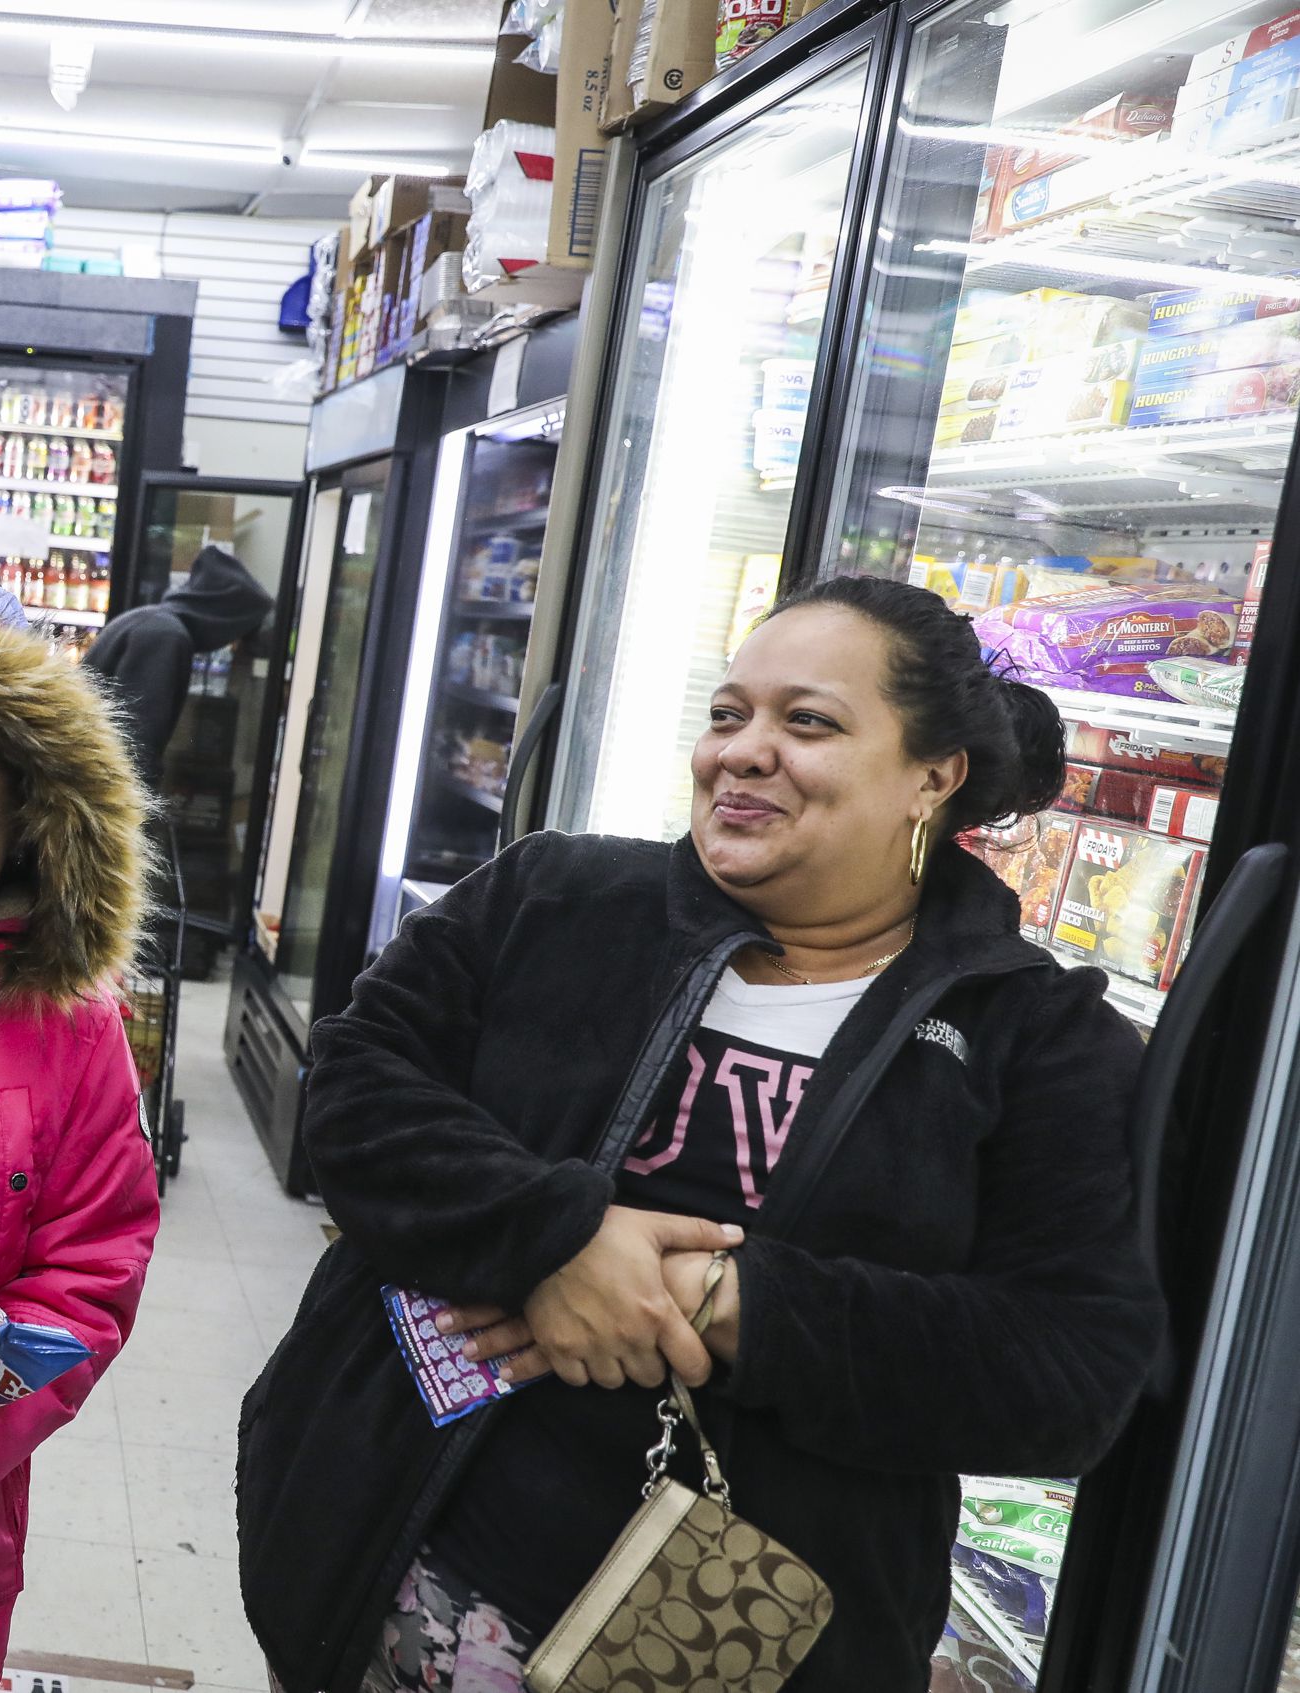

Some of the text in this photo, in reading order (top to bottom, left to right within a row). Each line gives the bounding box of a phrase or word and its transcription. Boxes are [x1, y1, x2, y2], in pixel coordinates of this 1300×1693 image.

[585, 69, 599, 93] 8.5
[1119, 621, 1170, 634] MONTEREY
[1117, 643, 1161, 652] BURRITOS
[1119, 742, 1154, 755] FRIDAYS
[1087, 840, 1118, 858] FRIDAYS
[915, 1023, 954, 1042] ORTH
[926, 1018, 954, 1035] THE
[917, 1032, 954, 1052] FACE
[400, 1325, 421, 1363] REMOVED
[427, 1364, 436, 1375] TO
[971, 1535, 1020, 1554] Garlic
